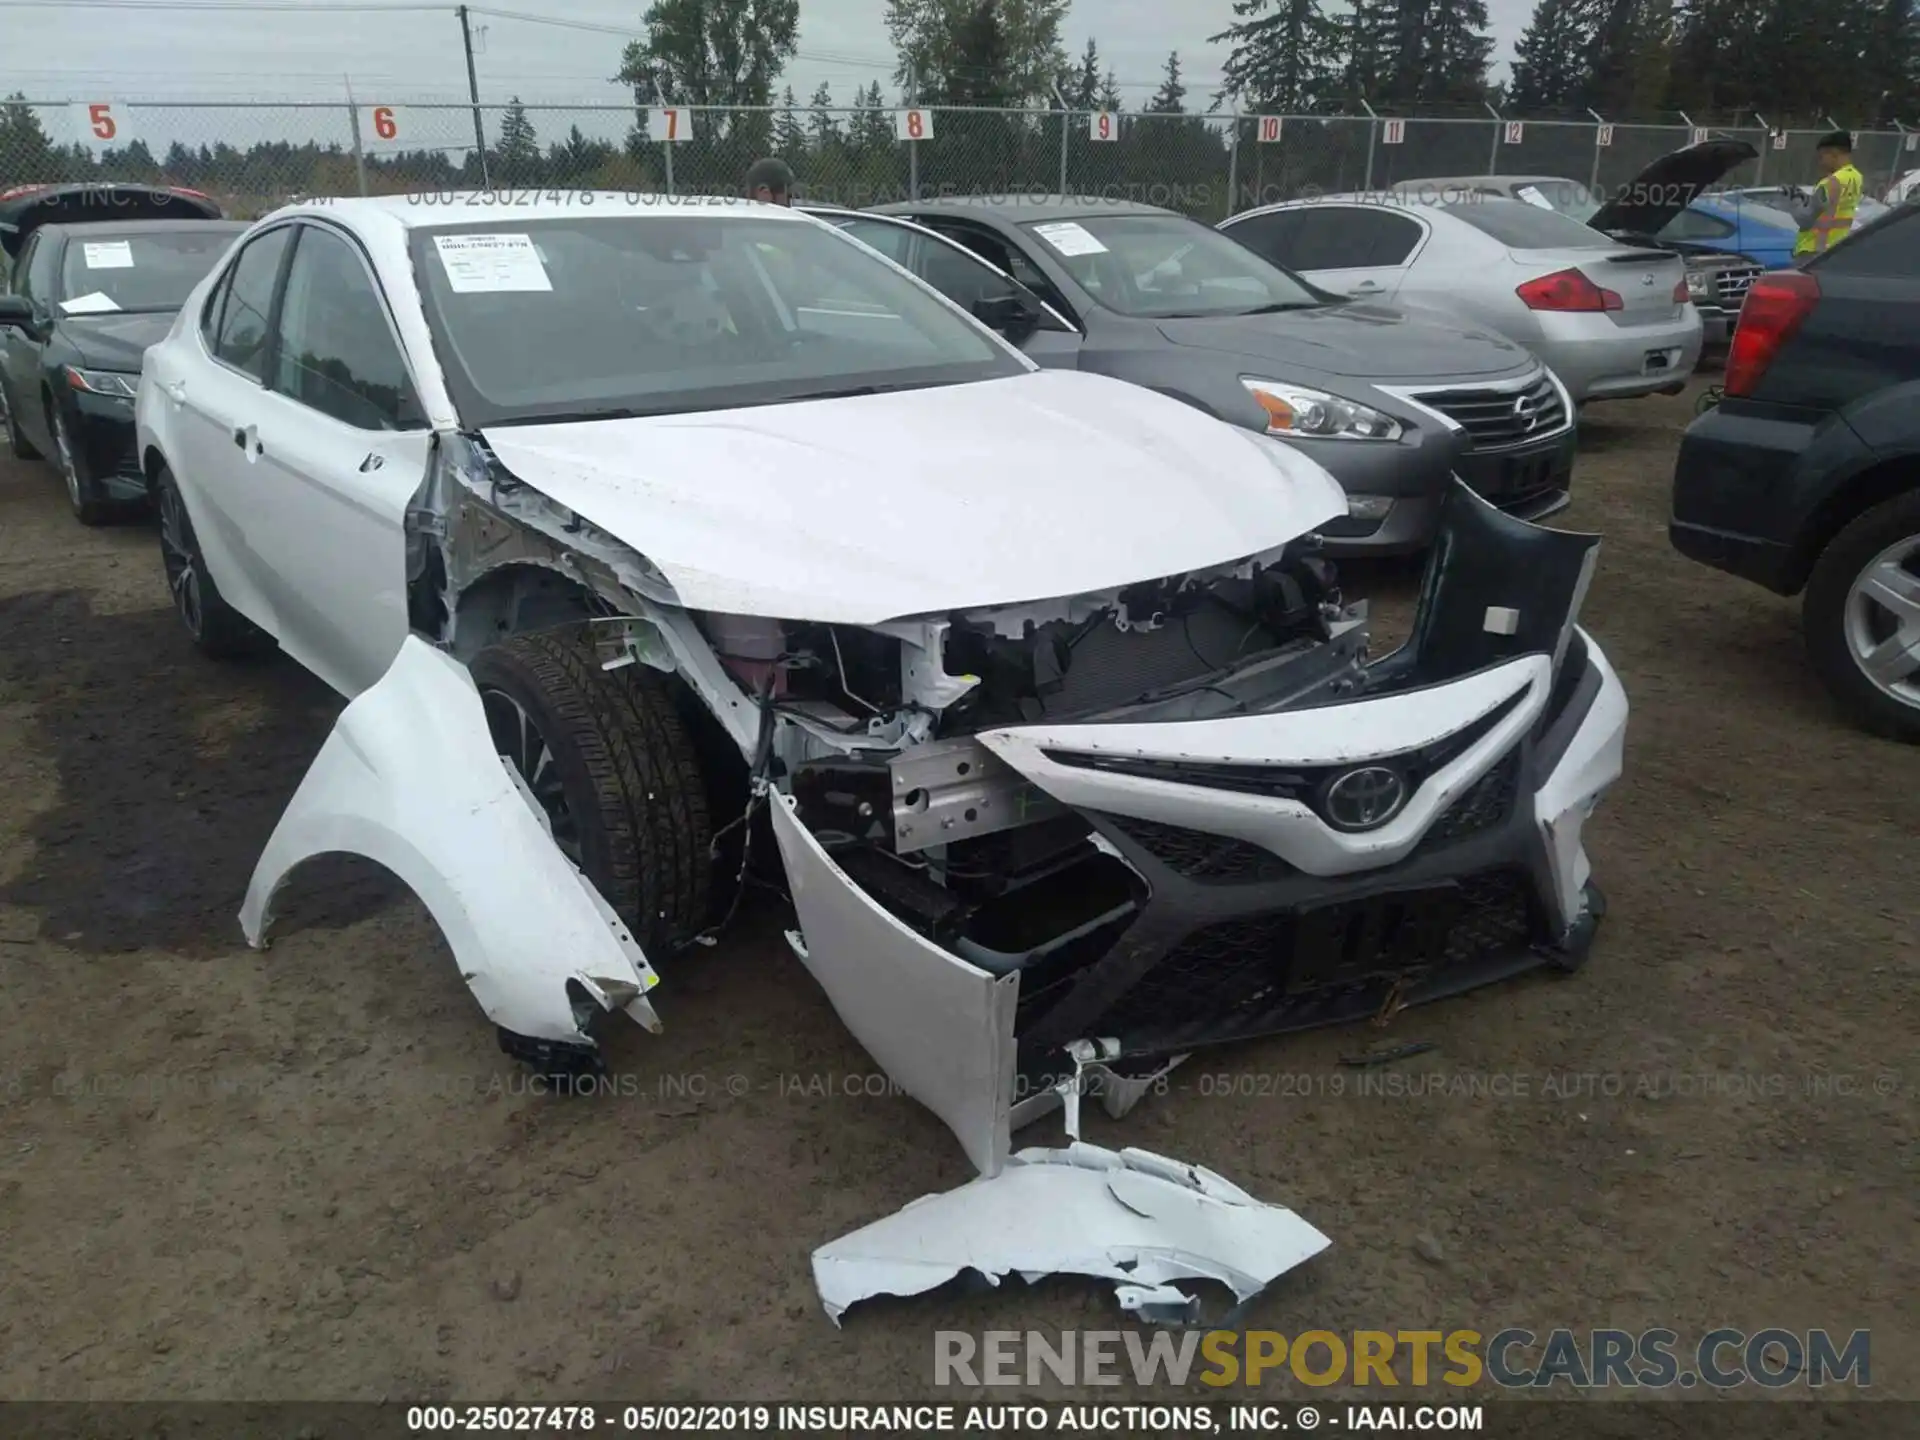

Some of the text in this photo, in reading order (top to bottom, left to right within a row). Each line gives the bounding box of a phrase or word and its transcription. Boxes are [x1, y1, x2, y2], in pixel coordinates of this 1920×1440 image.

[89, 104, 117, 139] 5
[375, 107, 397, 139] 6
[664, 109, 677, 139] 7
[907, 111, 922, 138] 8
[1099, 115, 1109, 139] 9
[1263, 117, 1278, 140] 10
[1389, 122, 1400, 141] 11
[1508, 123, 1520, 141] 12
